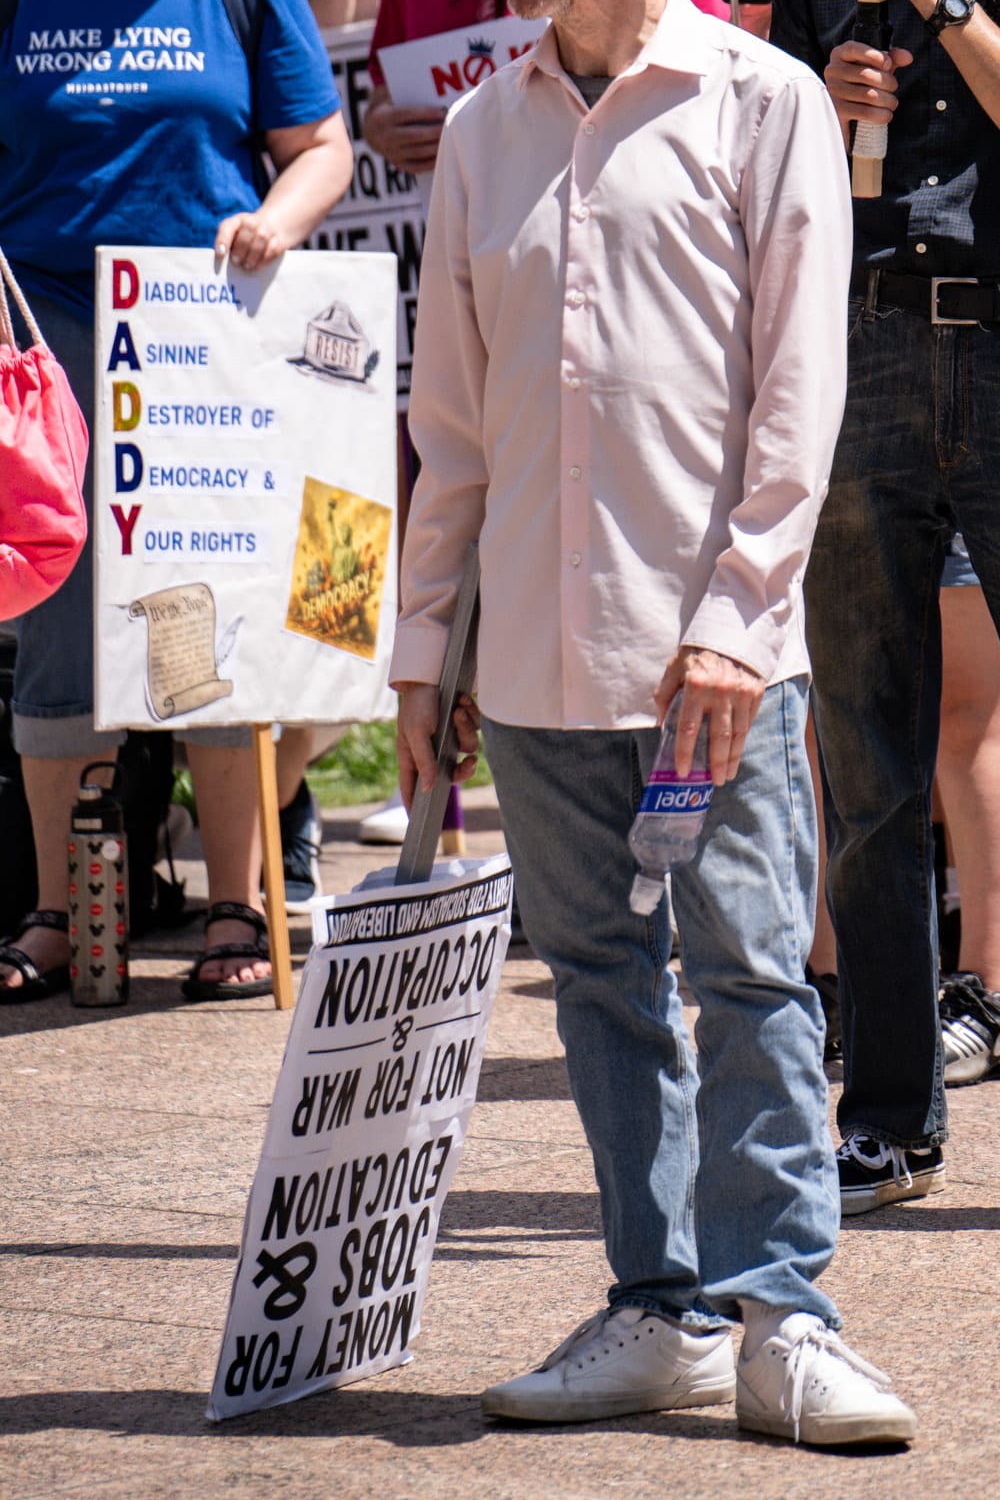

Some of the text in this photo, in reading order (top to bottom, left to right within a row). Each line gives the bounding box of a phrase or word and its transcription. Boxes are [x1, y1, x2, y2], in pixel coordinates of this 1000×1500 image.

[28, 27, 191, 51] MAKE LYING
[15, 51, 205, 74] WRONG AGAIN
[315, 334, 360, 369] RESIST
[251, 409, 275, 429] OF
[263, 470, 276, 491] &
[190, 532, 256, 552] RIGHTS
[328, 904, 397, 944] LIBERATION
[399, 901, 425, 933] AND
[314, 925, 499, 1029] OCCUPATION
[391, 1015, 414, 1052] &
[291, 1037, 475, 1137] NOT FOR WAR
[260, 1136, 453, 1242] EDUCATION
[251, 1206, 430, 1321] JOBS &
[226, 1291, 416, 1396] MONEY FOR
